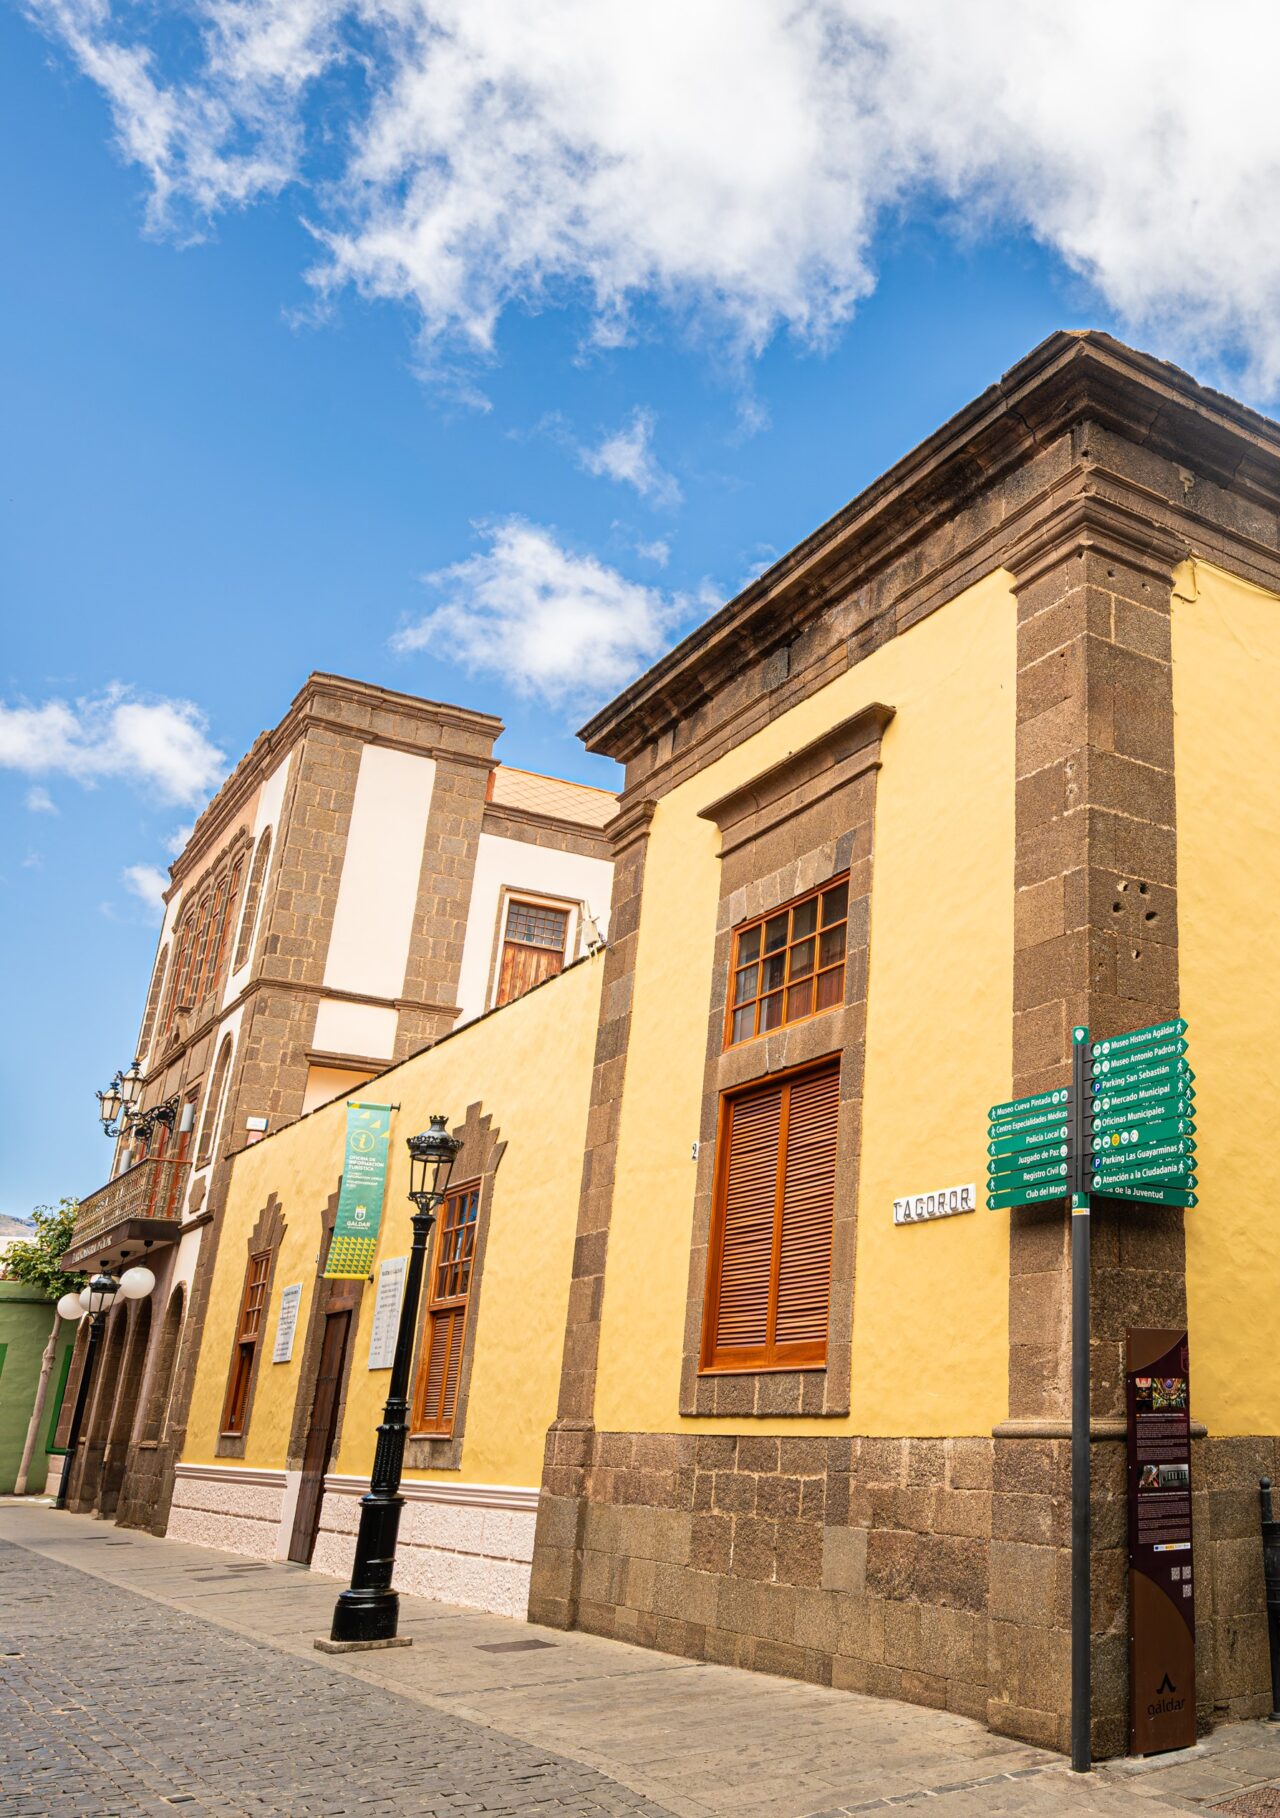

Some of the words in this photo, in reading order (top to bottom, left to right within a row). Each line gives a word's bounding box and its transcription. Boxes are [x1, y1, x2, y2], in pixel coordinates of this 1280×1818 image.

[1111, 1040, 1129, 1049] Museo
[1130, 1032, 1151, 1043] Historia
[1153, 1025, 1175, 1038] Agáldar
[1111, 1059, 1129, 1068] Museo
[1130, 1050, 1153, 1062] Antonio
[1154, 1045, 1175, 1056] Padrón
[1102, 1077, 1125, 1088] Parking
[1139, 1065, 1169, 1080] Sebastián
[1111, 1093, 1137, 1105] Mercado
[1139, 1083, 1170, 1099] Municipal
[997, 1107, 1013, 1115] Museo
[1014, 1103, 1030, 1111] Cueva
[1031, 1096, 1051, 1107] Pintada
[996, 1125, 1011, 1133] Centro
[1013, 1115, 1046, 1130] Especialidades
[1047, 1110, 1068, 1120] Médicas
[1102, 1115, 1126, 1127] Oficinas
[1127, 1106, 1165, 1120] Municipales
[1026, 1133, 1043, 1144] Policía
[1045, 1129, 1059, 1140] Local
[1018, 1153, 1040, 1164] Juzgado
[1050, 1149, 1059, 1157] Paz
[1102, 1155, 1125, 1165] Parking
[1126, 1153, 1136, 1161] Las
[1137, 1145, 1177, 1159] Guayarminas
[1023, 1171, 1045, 1181] Registro
[1046, 1166, 1058, 1175] Civil
[1102, 1173, 1129, 1184] Atención
[1135, 1170, 1141, 1178] la
[1142, 1163, 1177, 1177] Ciudadanía
[1026, 1189, 1038, 1198] Club
[1040, 1187, 1048, 1195] del
[1050, 1185, 1067, 1194] Mayor
[1125, 1187, 1131, 1195] la
[1133, 1188, 1164, 1199] Juventud
[893, 1187, 971, 1222] TAGOROR
[1147, 1697, 1185, 1720] gáldar
